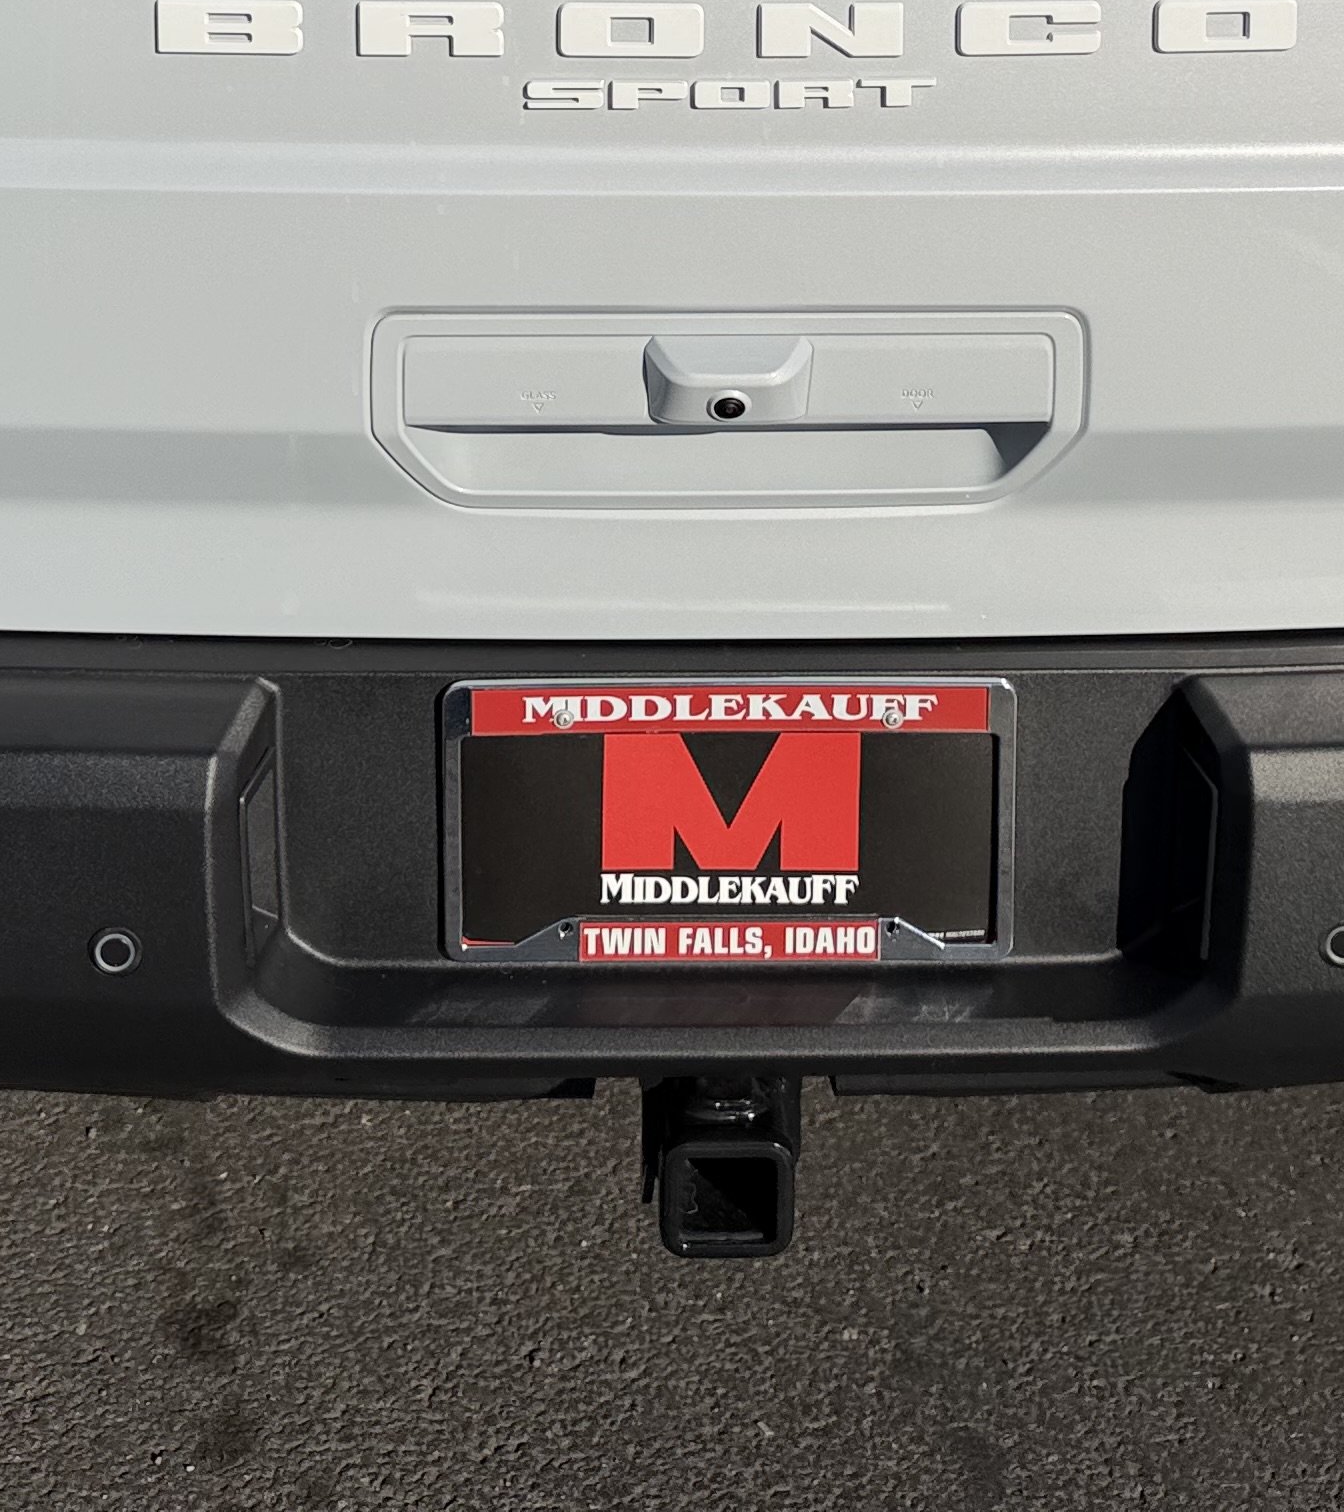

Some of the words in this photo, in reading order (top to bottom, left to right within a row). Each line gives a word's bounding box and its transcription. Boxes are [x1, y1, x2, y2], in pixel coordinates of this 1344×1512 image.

[522, 77, 937, 110] SPORT
[520, 390, 557, 401] GLASS
[900, 388, 935, 400] DOOR
[522, 694, 939, 723] MIDDLEKAUFF
[602, 732, 862, 871] M
[600, 873, 860, 905] MIDDLEKAUFF
[583, 925, 670, 955] TWIN
[678, 924, 773, 959] FALLS,
[785, 924, 876, 955] IDAHO
